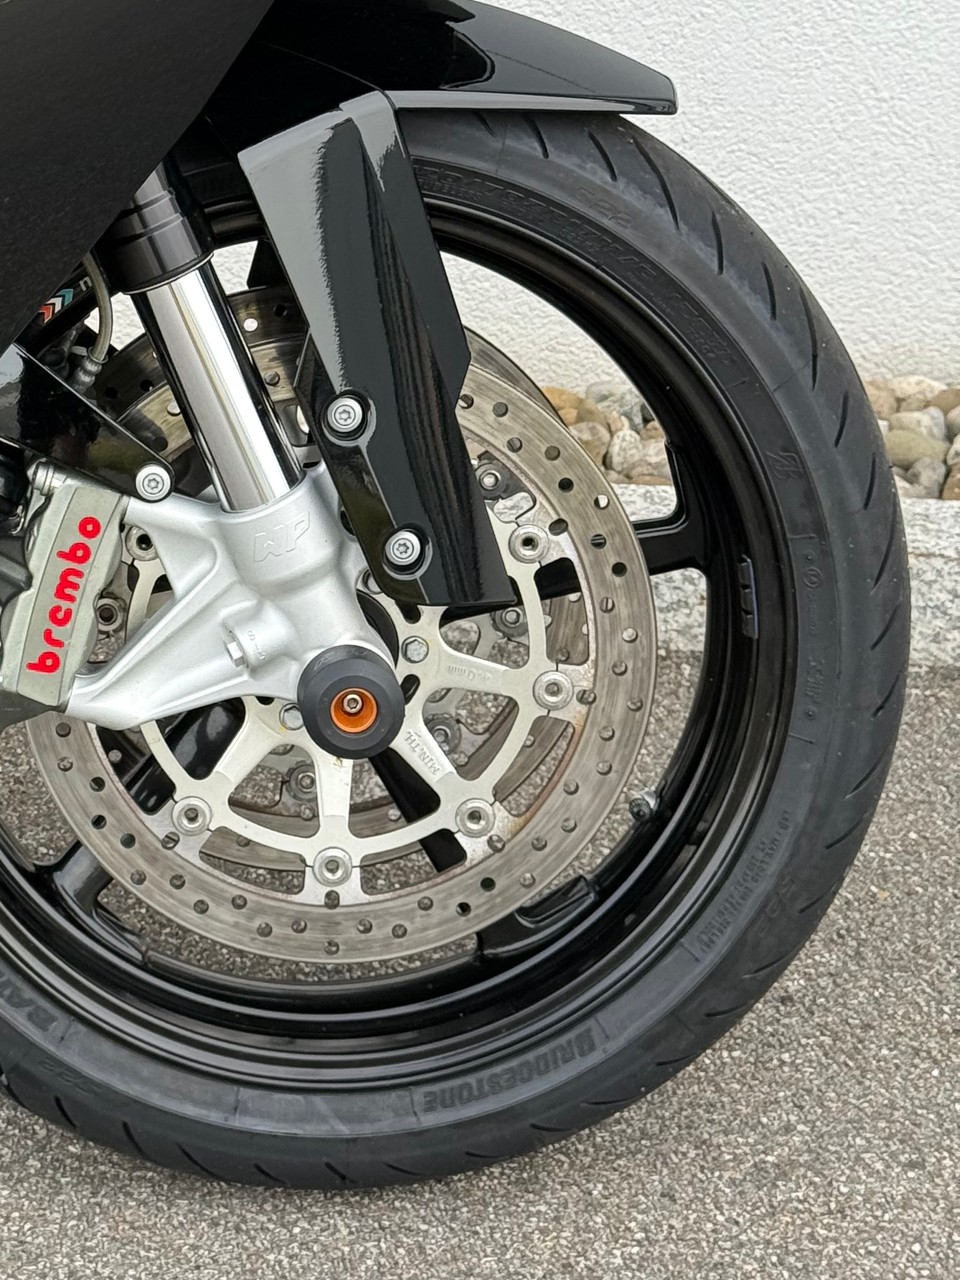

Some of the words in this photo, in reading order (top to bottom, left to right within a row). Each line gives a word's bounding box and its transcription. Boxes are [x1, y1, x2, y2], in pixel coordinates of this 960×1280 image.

[253, 510, 311, 563] WP
[25, 516, 102, 674] brembo
[422, 1024, 597, 1113] BRIDGESTONE
